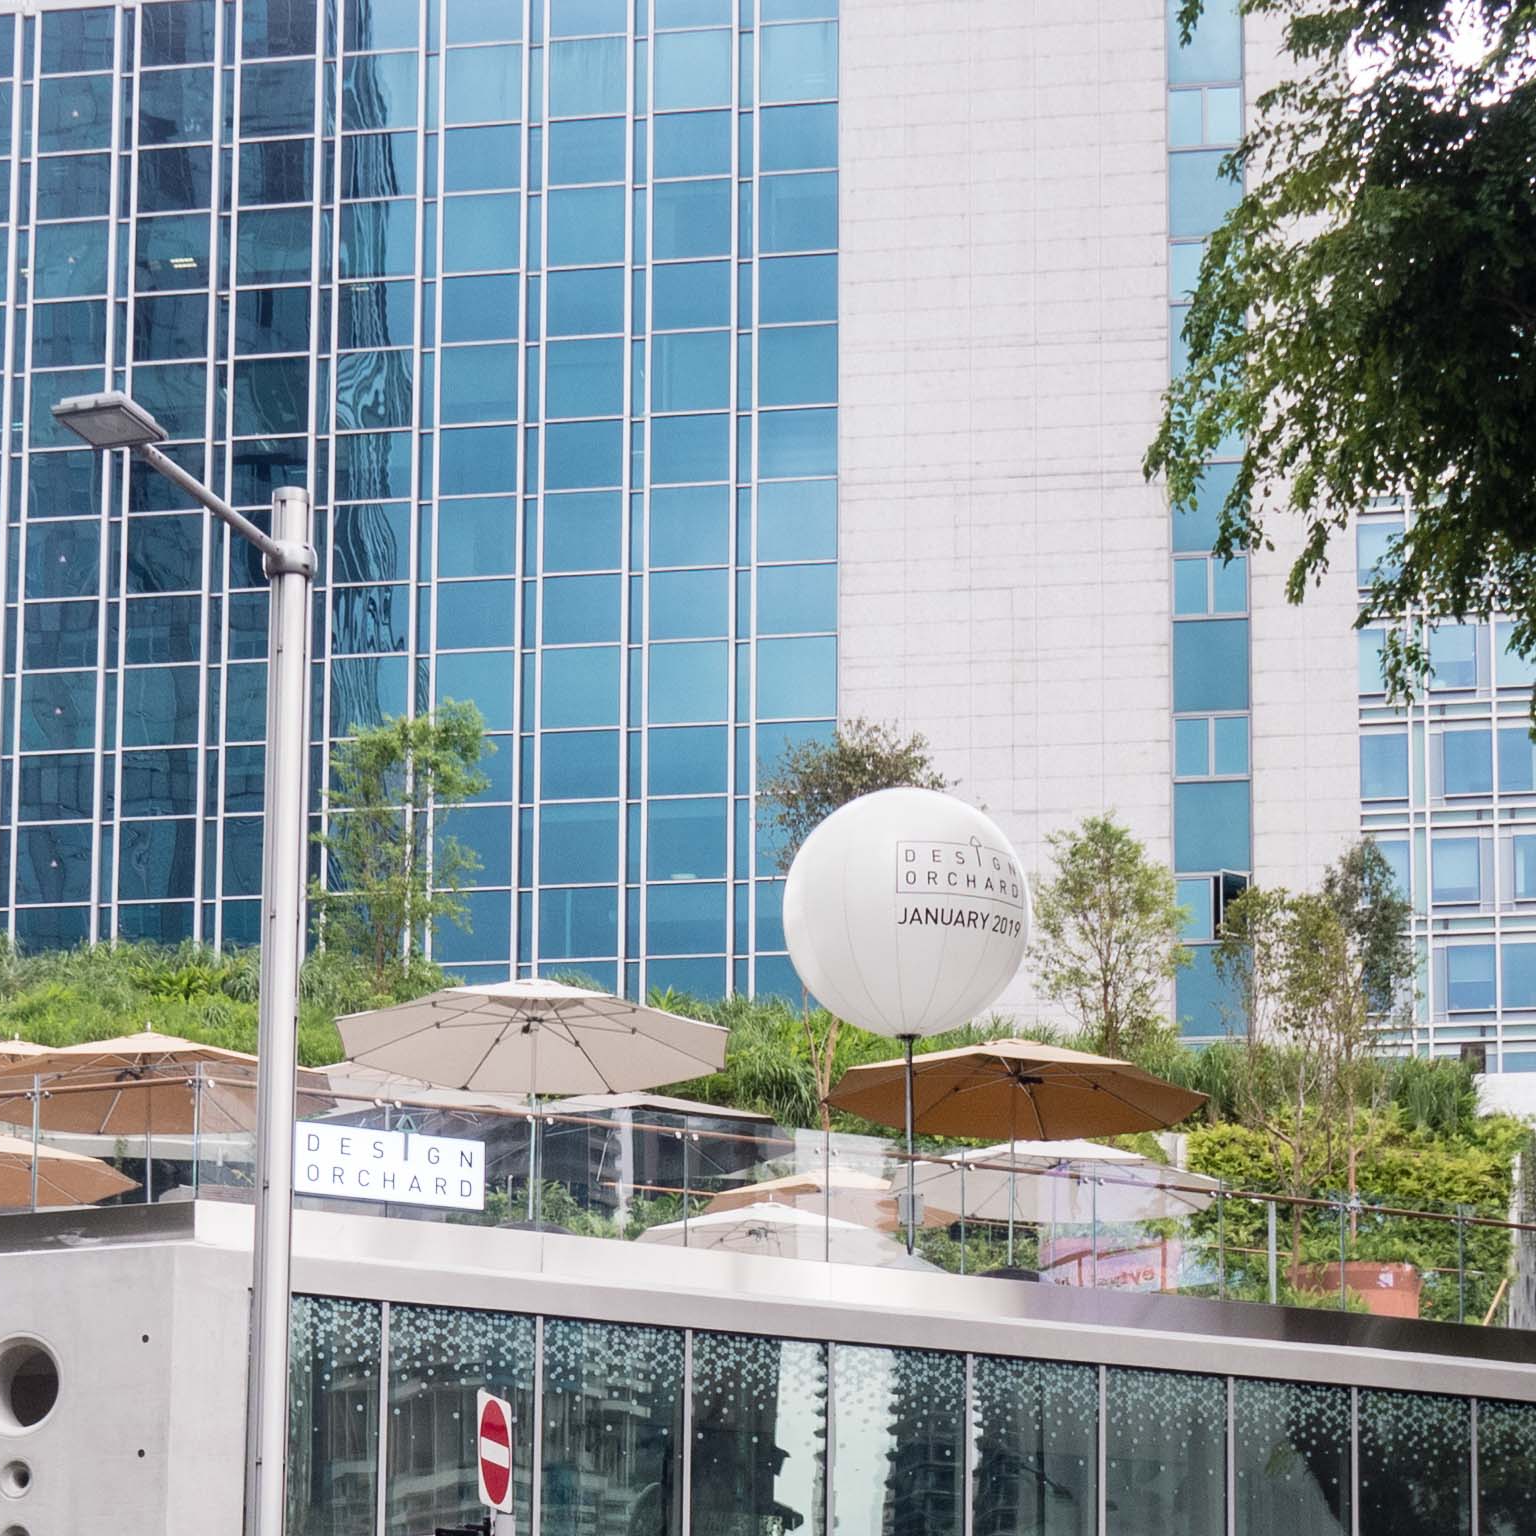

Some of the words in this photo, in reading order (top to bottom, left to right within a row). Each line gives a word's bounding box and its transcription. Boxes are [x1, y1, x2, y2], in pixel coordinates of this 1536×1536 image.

[904, 847, 1017, 876] DESIGN
[905, 870, 1019, 898] ORCHARD
[897, 907, 990, 930] JANUARY
[991, 914, 1021, 938] 2019
[307, 1132, 473, 1168] DESIGN
[307, 1163, 472, 1198] ORCHARD
